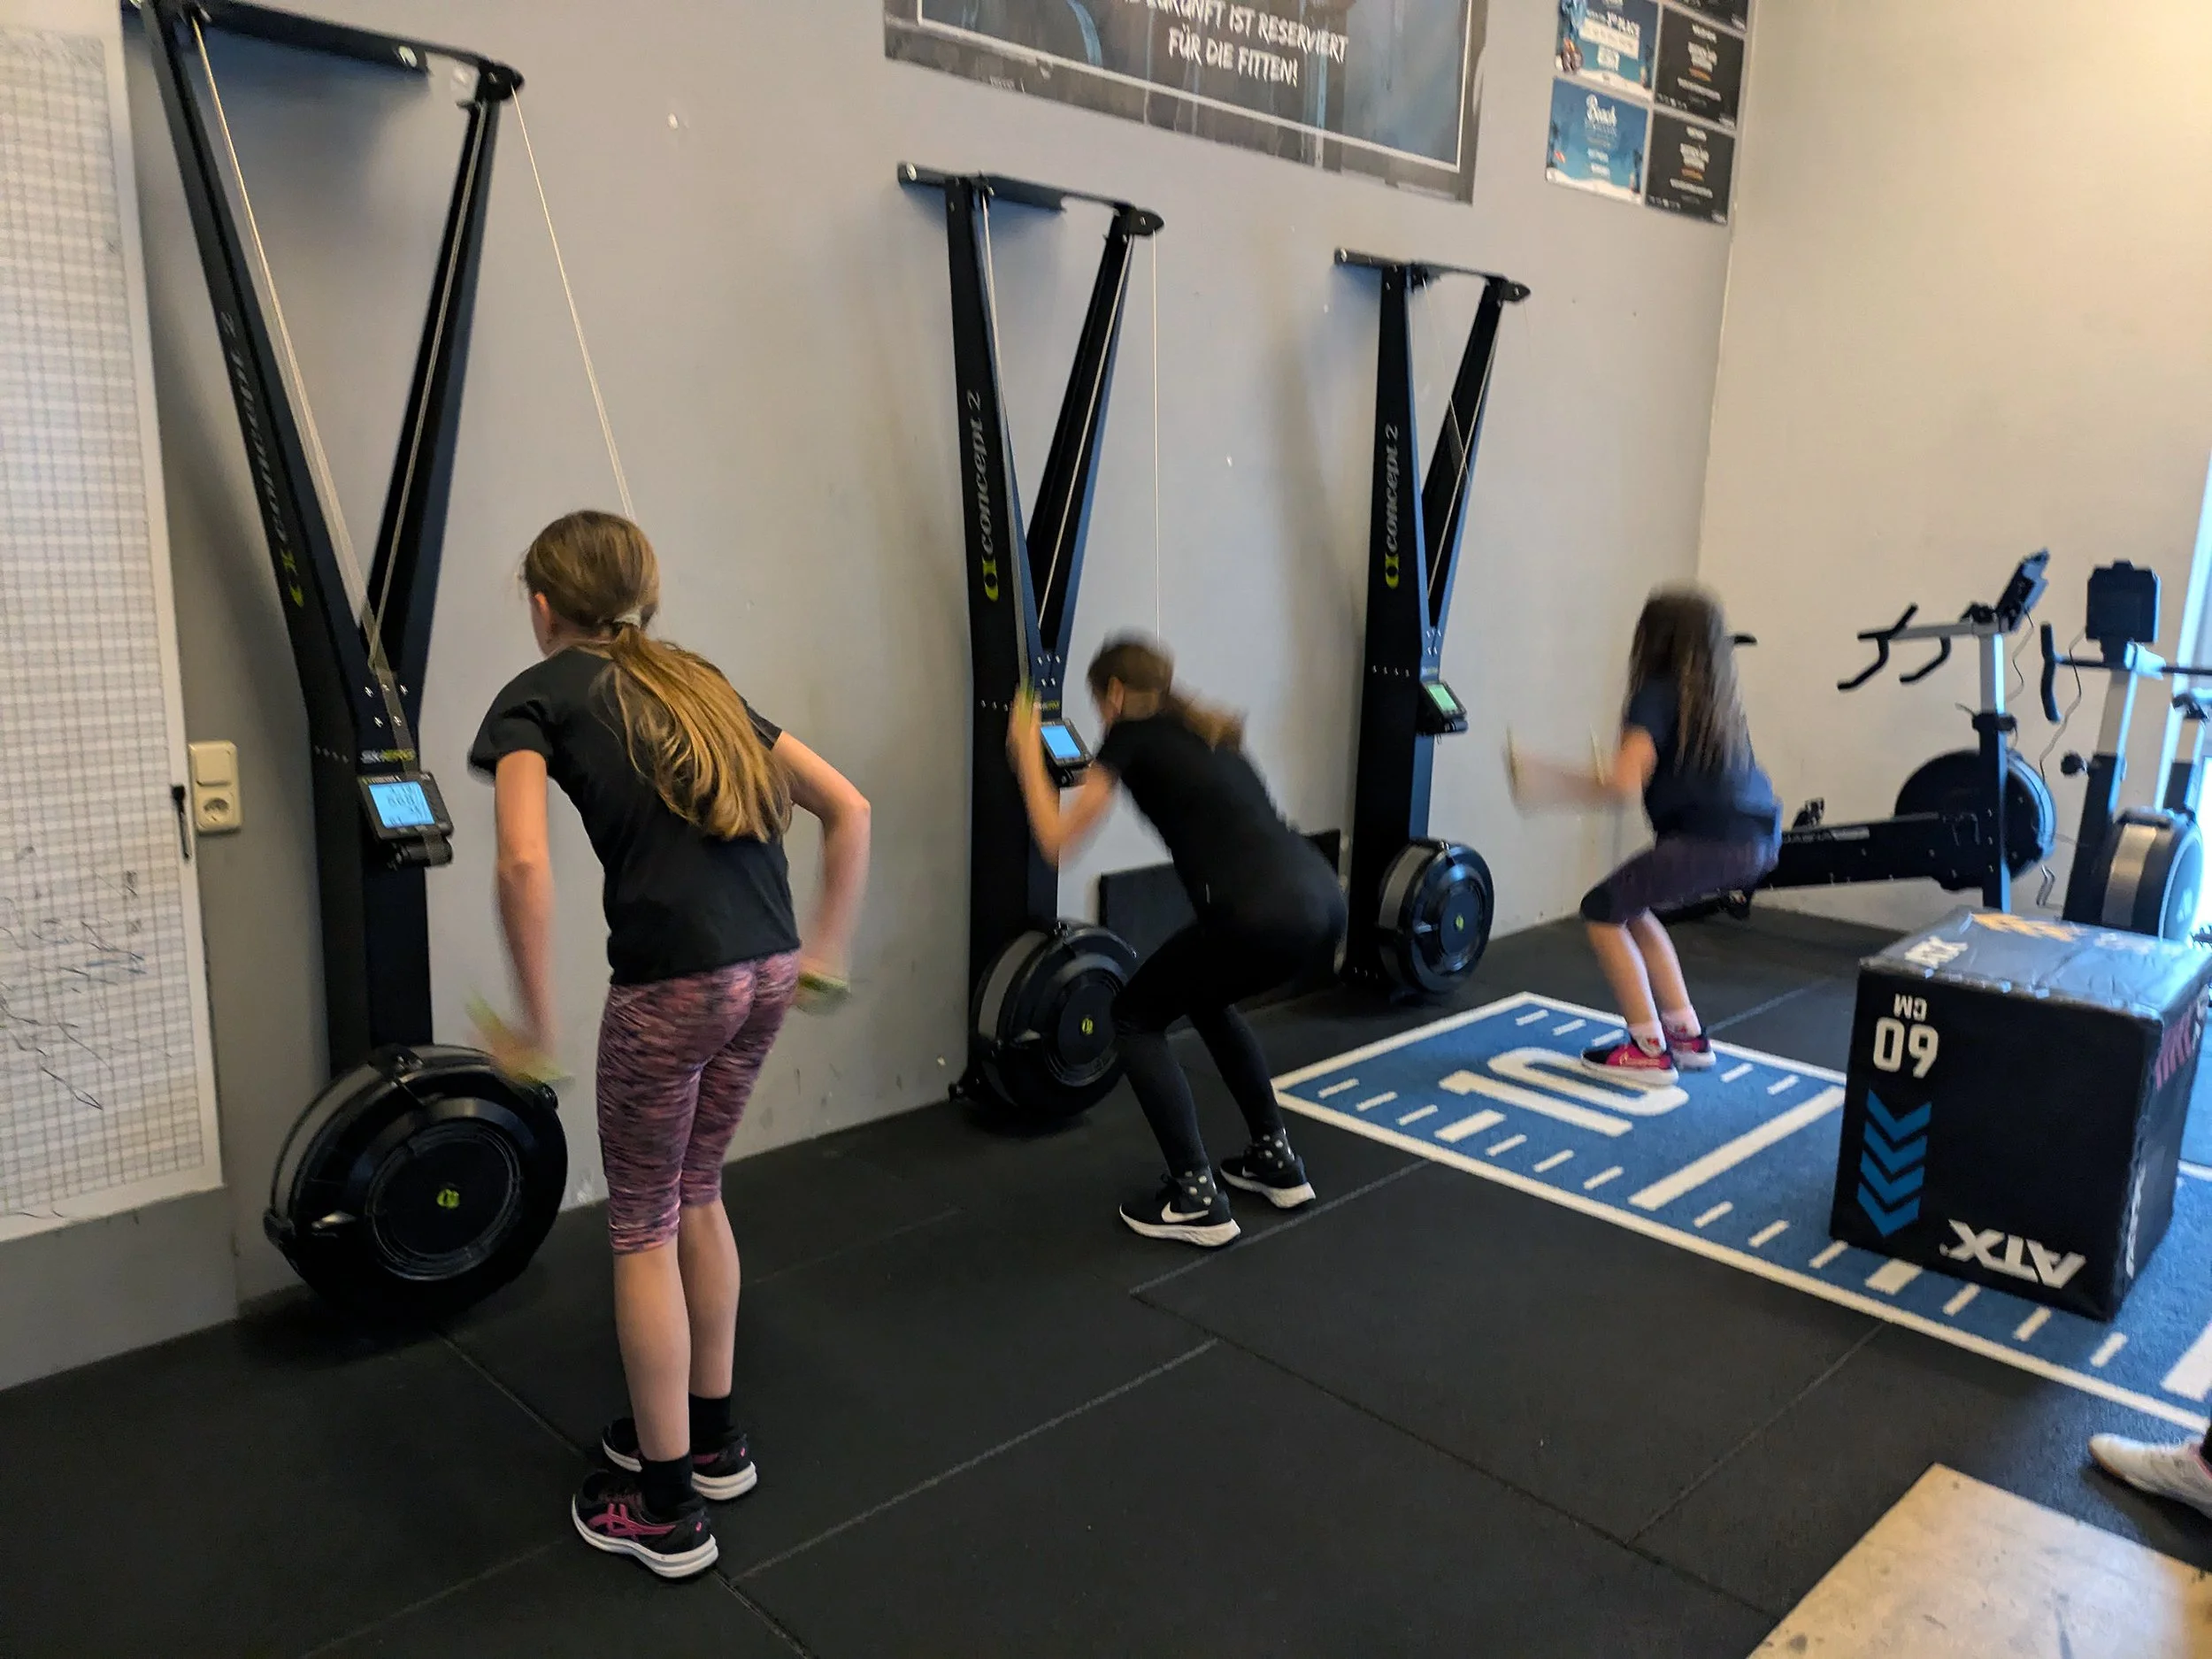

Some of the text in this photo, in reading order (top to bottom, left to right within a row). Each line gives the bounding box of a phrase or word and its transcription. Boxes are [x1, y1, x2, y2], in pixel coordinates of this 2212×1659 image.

[1168, 22, 1298, 88] FÜR DIE FITTEN!
[1229, 4, 1256, 37] IST
[1258, 12, 1349, 64] RESERVIERT
[966, 388, 995, 557] concept 2
[1384, 422, 1400, 553] concept 2
[1893, 993, 1928, 1022] CM
[1439, 1047, 1691, 1139] 10
